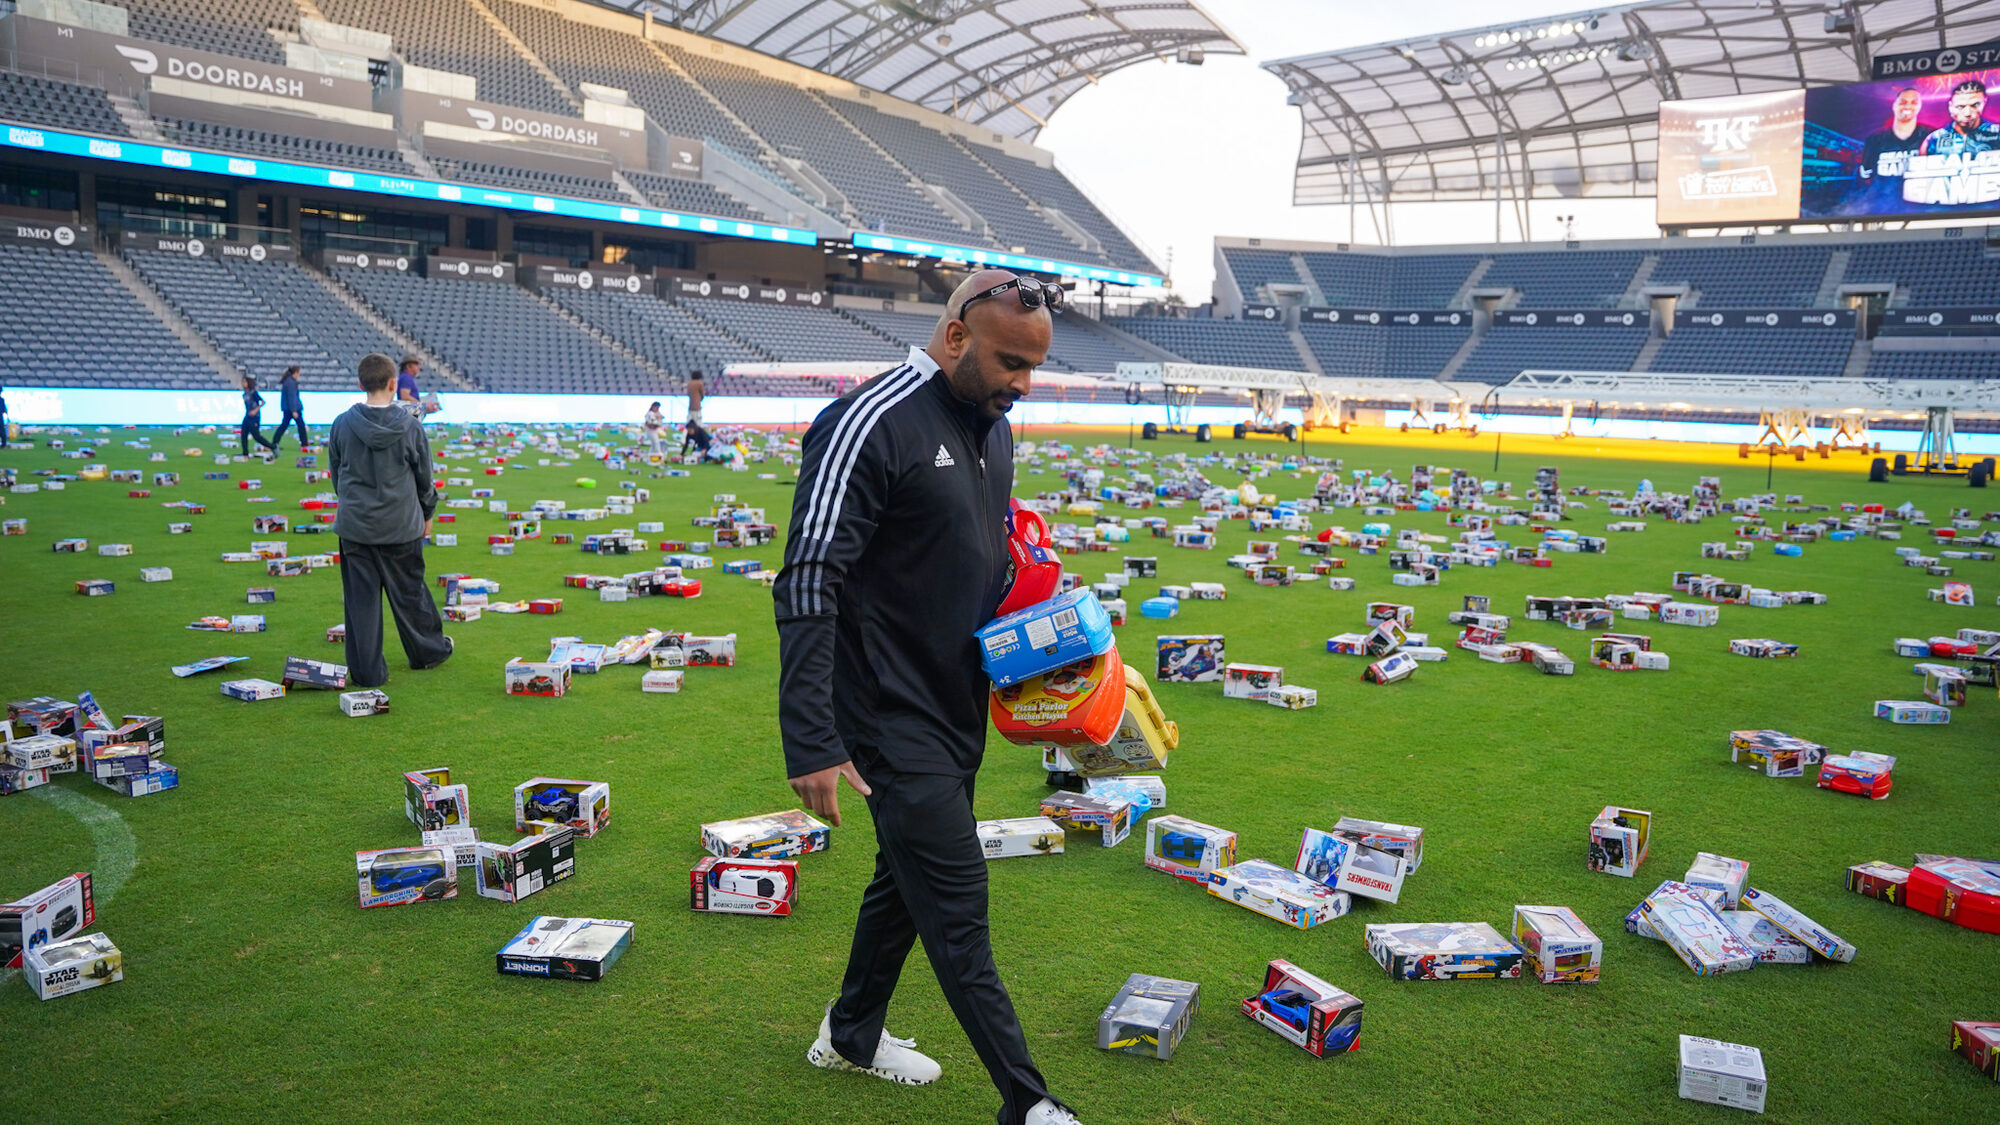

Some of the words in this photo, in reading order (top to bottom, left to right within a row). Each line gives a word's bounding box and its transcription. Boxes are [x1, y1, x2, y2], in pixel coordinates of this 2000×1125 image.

[58, 27, 74, 39] M1
[1882, 57, 1931, 75] BMO
[168, 58, 304, 98] DOORDASH
[501, 115, 599, 147] DOORDASH
[1902, 175, 2000, 205] GAME
[17, 226, 51, 240] BMO
[158, 240, 186, 252] BMO
[223, 245, 249, 257] BMO
[336, 254, 356, 265] BMO
[377, 258, 396, 268] BMO
[439, 262, 458, 272] BMO
[474, 265, 492, 275] BMO
[553, 272, 577, 285] BMO
[603, 276, 626, 288] BMO
[1745, 315, 1765, 323] BMO
[1801, 315, 1822, 323] BMO
[1905, 315, 1927, 324] BMO
[1970, 314, 1994, 323] BMO
[934, 458, 955, 468] adidas
[999, 675, 1012, 684] 3+
[1014, 703, 1037, 712] Pizza
[1039, 703, 1069, 711] Parlor
[1012, 713, 1040, 721] Kitchen
[1042, 712, 1068, 721] Playset
[1346, 872, 1393, 893] TRANSFORMERS
[363, 888, 414, 906] LAMBORGHINI
[733, 902, 753, 910] BUGATTI
[1548, 943, 1564, 952] FORD
[1555, 946, 1582, 955] MUSTANG
[1583, 943, 1592, 951] GT
[48, 966, 79, 979] STAR
[504, 961, 549, 974] HORNET
[45, 974, 80, 986] WARS
